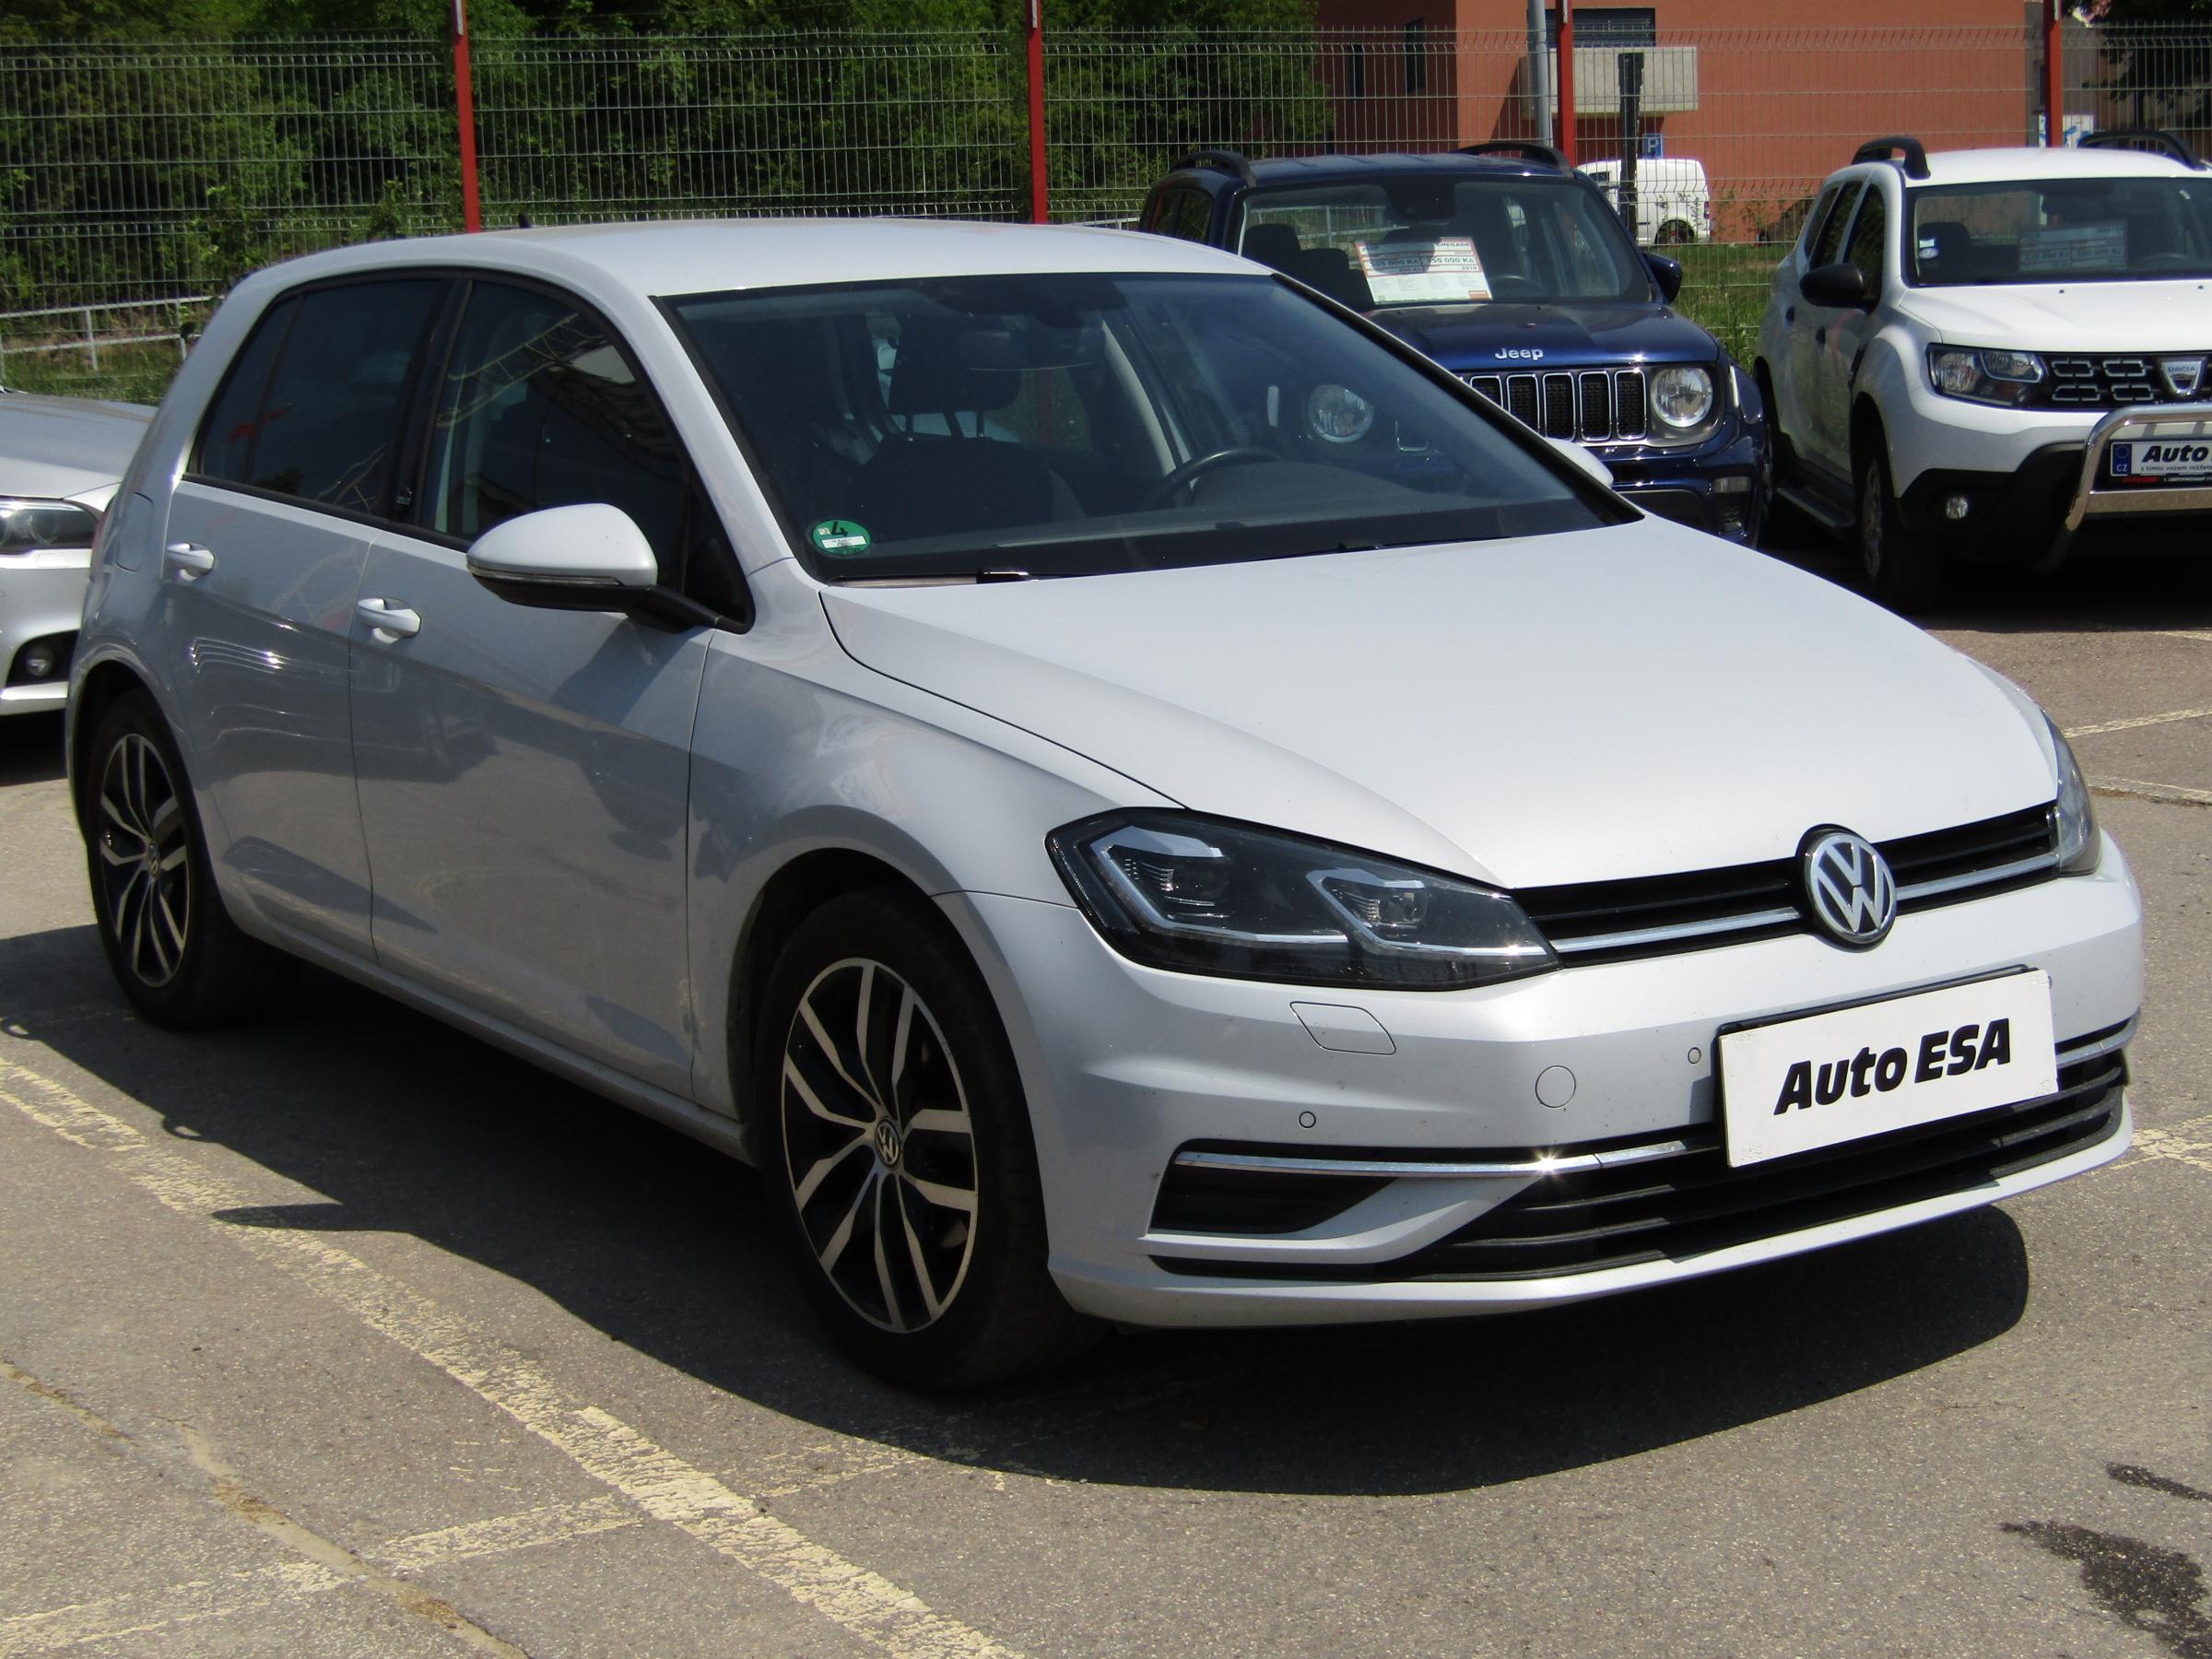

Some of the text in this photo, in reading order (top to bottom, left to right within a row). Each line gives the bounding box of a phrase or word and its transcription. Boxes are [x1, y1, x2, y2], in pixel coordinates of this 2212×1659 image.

[1647, 137, 1659, 153] P
[1494, 347, 1544, 361] Jeep
[2141, 444, 2209, 463] Auto
[2116, 464, 2128, 473] CZ
[830, 521, 848, 536] 4
[1773, 1018, 2010, 1115] Auto ESA
